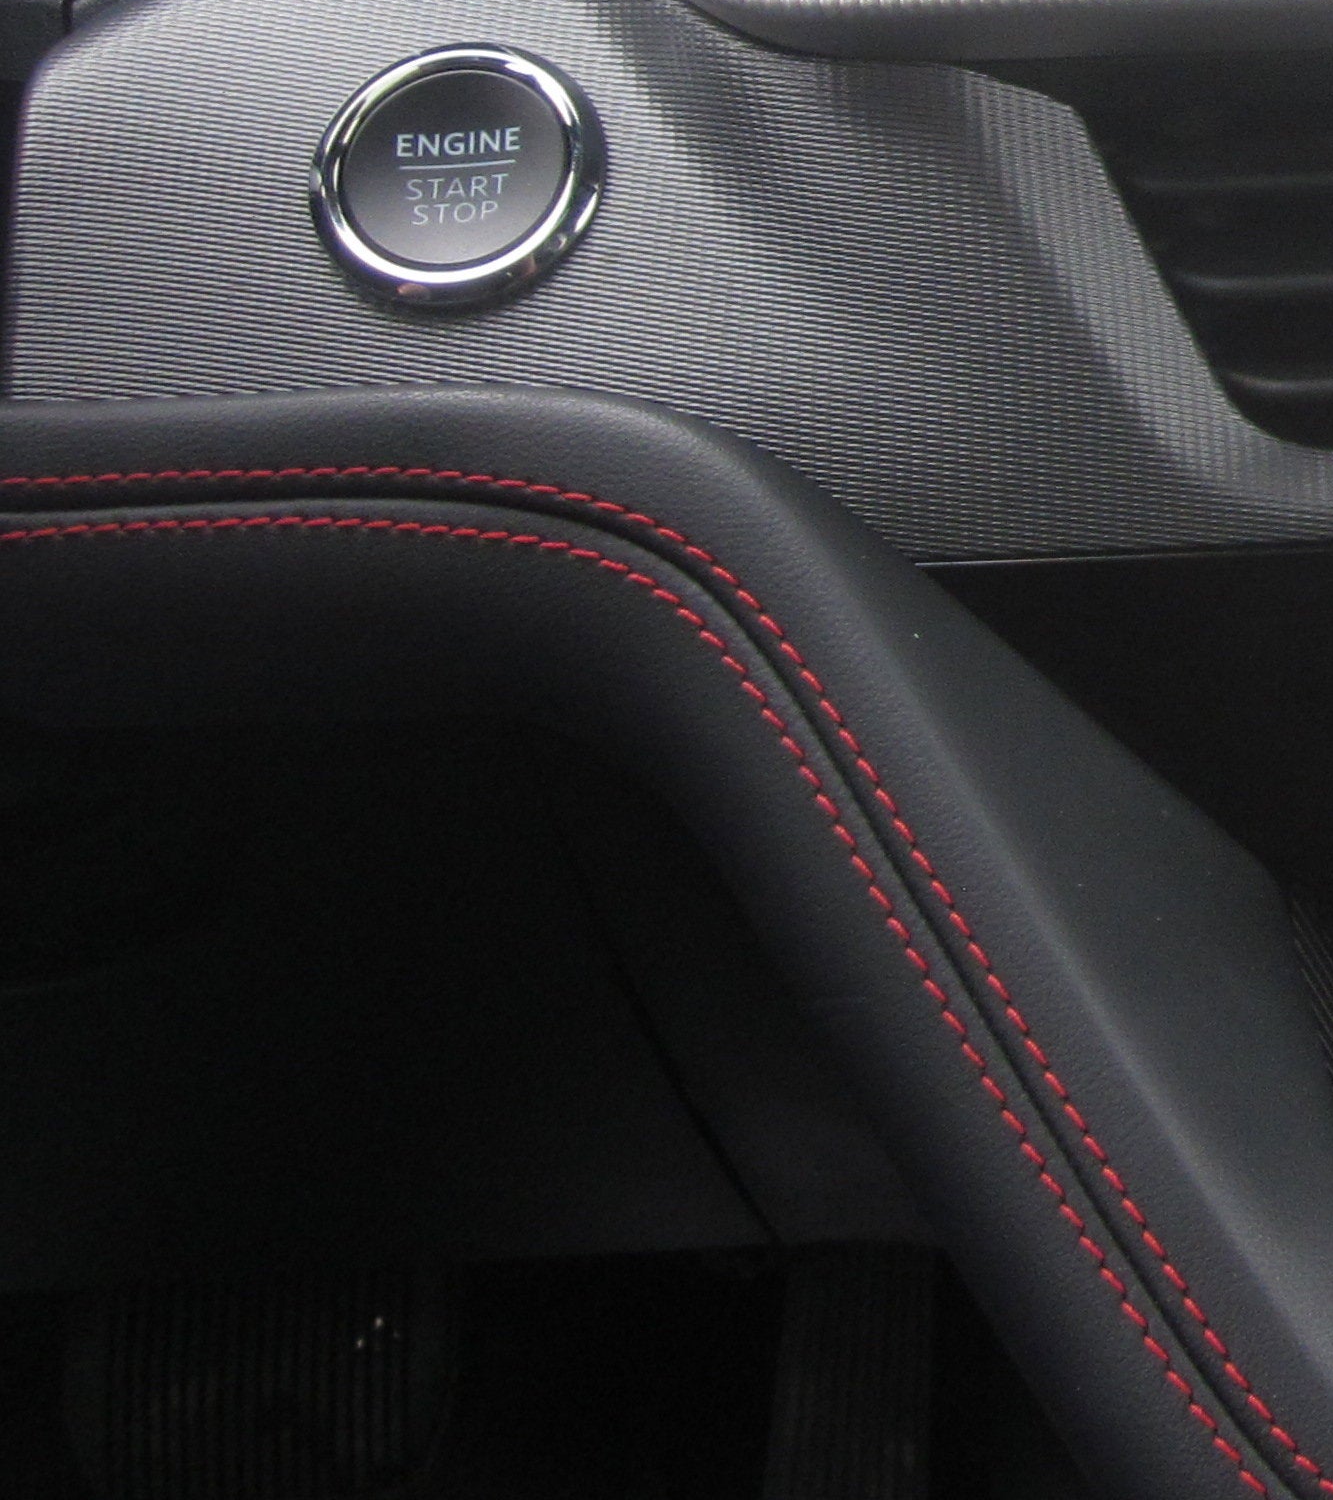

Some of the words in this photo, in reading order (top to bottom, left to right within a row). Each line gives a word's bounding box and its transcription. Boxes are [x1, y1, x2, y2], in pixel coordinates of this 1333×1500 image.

[395, 126, 523, 158] ENGINE
[404, 172, 510, 201] START
[410, 200, 499, 226] STOP
